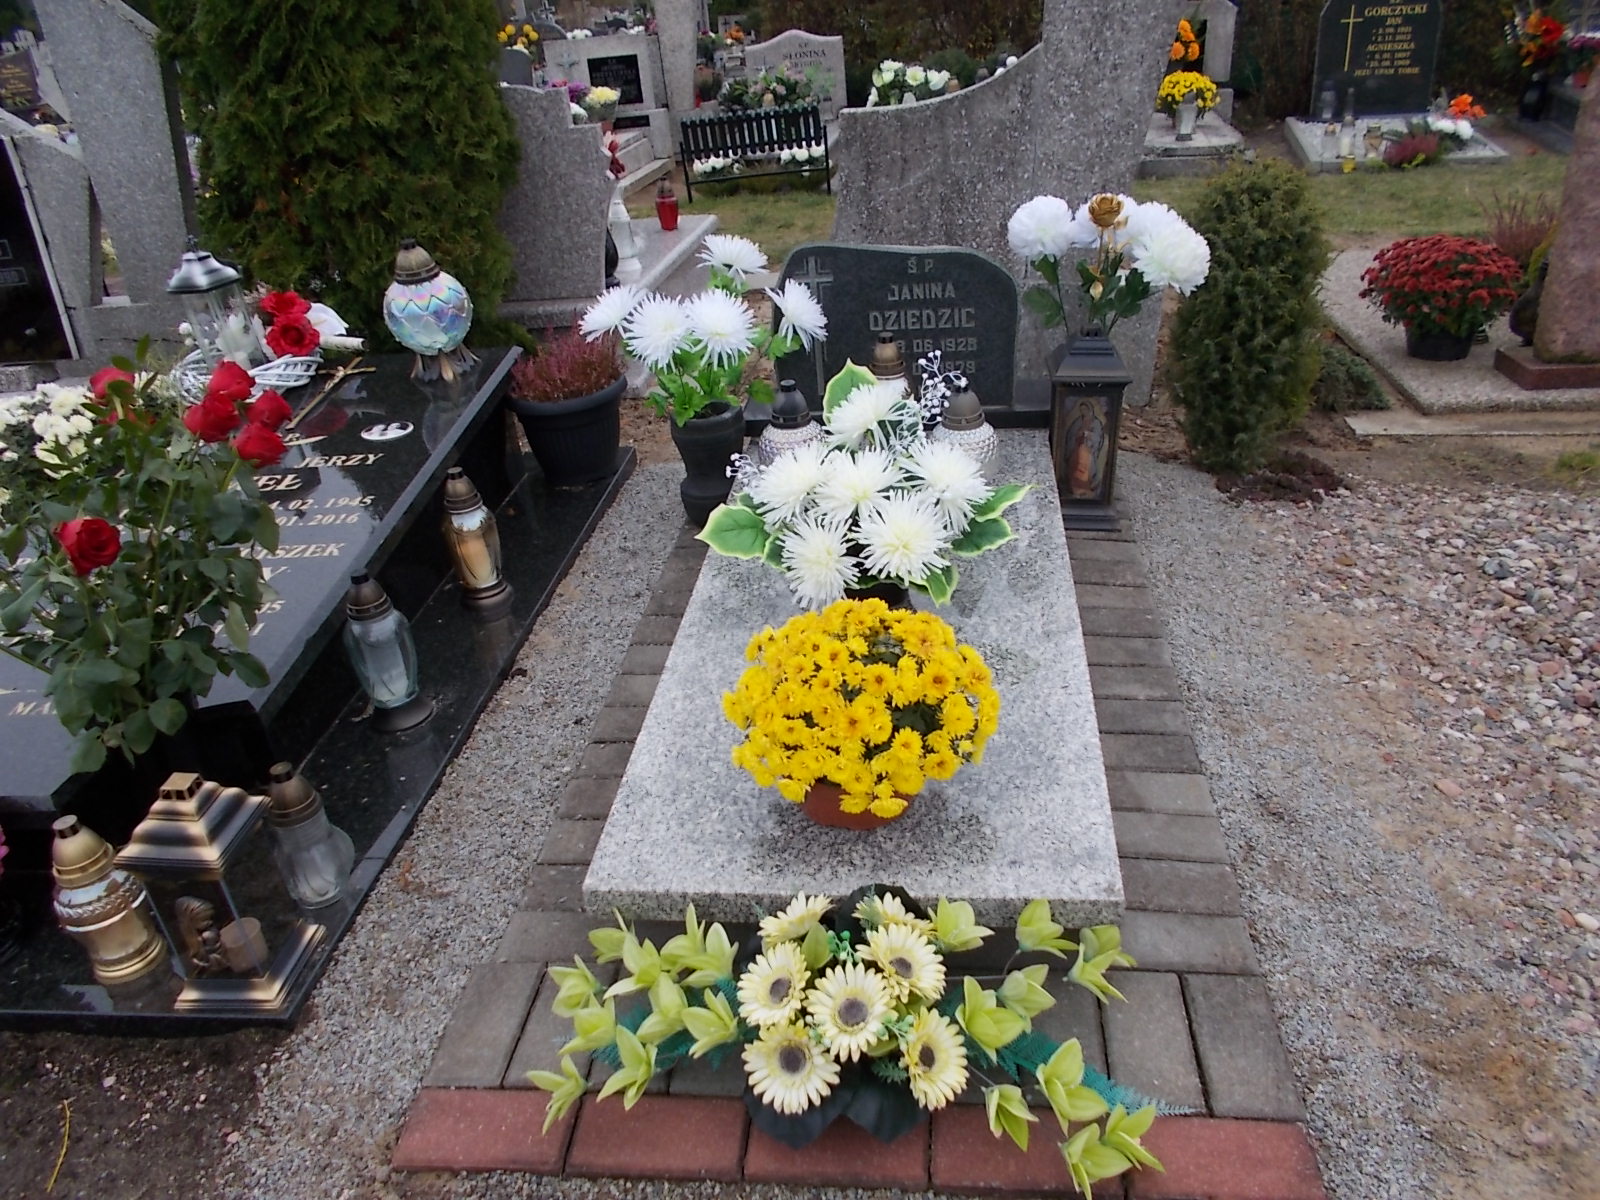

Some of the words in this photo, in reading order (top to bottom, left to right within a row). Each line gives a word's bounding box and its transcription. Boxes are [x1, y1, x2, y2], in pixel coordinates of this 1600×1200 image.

[887, 281, 956, 301] JANINA
[868, 308, 976, 331] DZIEDZIC
[941, 337, 977, 352] 1928
[294, 453, 385, 468] JERZY
